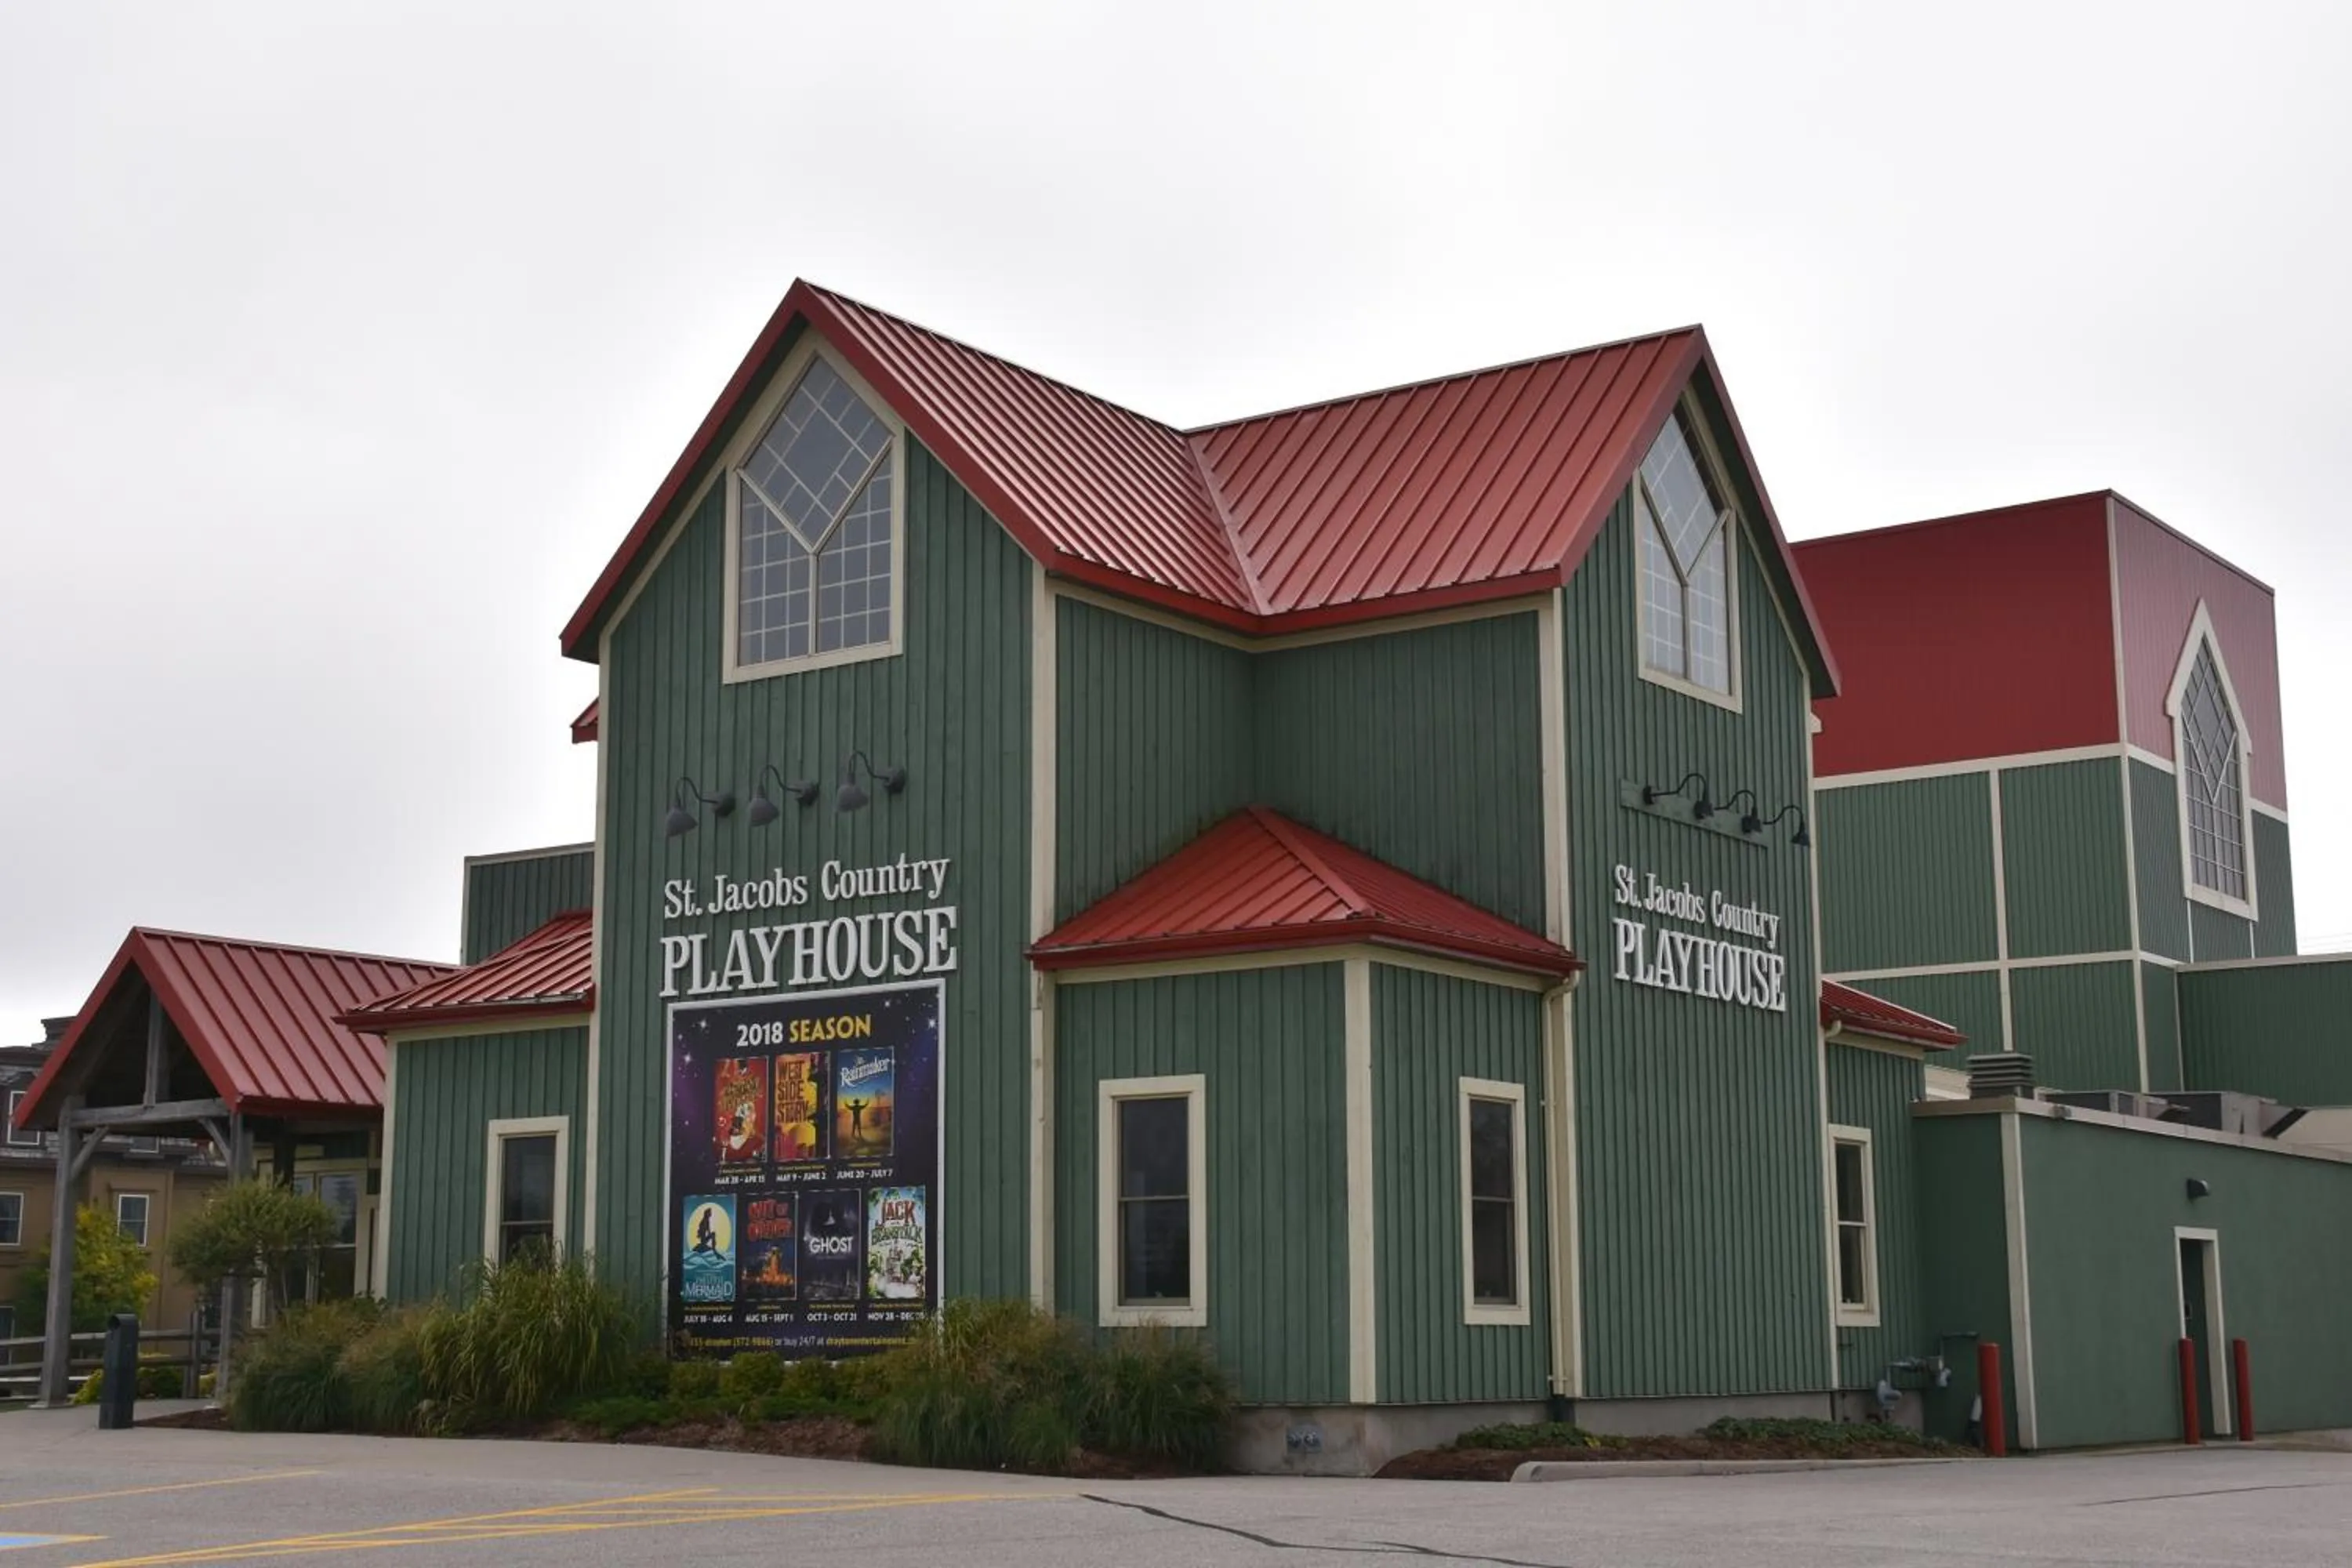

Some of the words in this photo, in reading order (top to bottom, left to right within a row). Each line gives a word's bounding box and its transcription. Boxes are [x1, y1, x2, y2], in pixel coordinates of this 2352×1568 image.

[664, 879, 703, 919] St.
[708, 868, 808, 915] Jacobs
[821, 853, 951, 901] Country
[1614, 864, 1642, 908] St.
[1644, 873, 1705, 924] Jacobs
[1711, 890, 1780, 949] Country
[659, 906, 958, 997] PLAYHOUSE
[1613, 917, 1786, 1012] PLAYHOUSE
[735, 1022, 783, 1047] 2018
[789, 1014, 873, 1044] SEASON
[778, 1060, 804, 1080] WEST
[777, 1080, 804, 1101] SIDE
[777, 1101, 809, 1123] STORY
[875, 1200, 916, 1228] JACK
[809, 1236, 854, 1254] GHOST
[684, 1281, 733, 1297] MERMAID
[746, 1314, 760, 1323] AUG
[774, 1313, 789, 1323] SEPT
[807, 1312, 821, 1322] OCT
[833, 1312, 848, 1321] OCT
[867, 1312, 884, 1321] NOV
